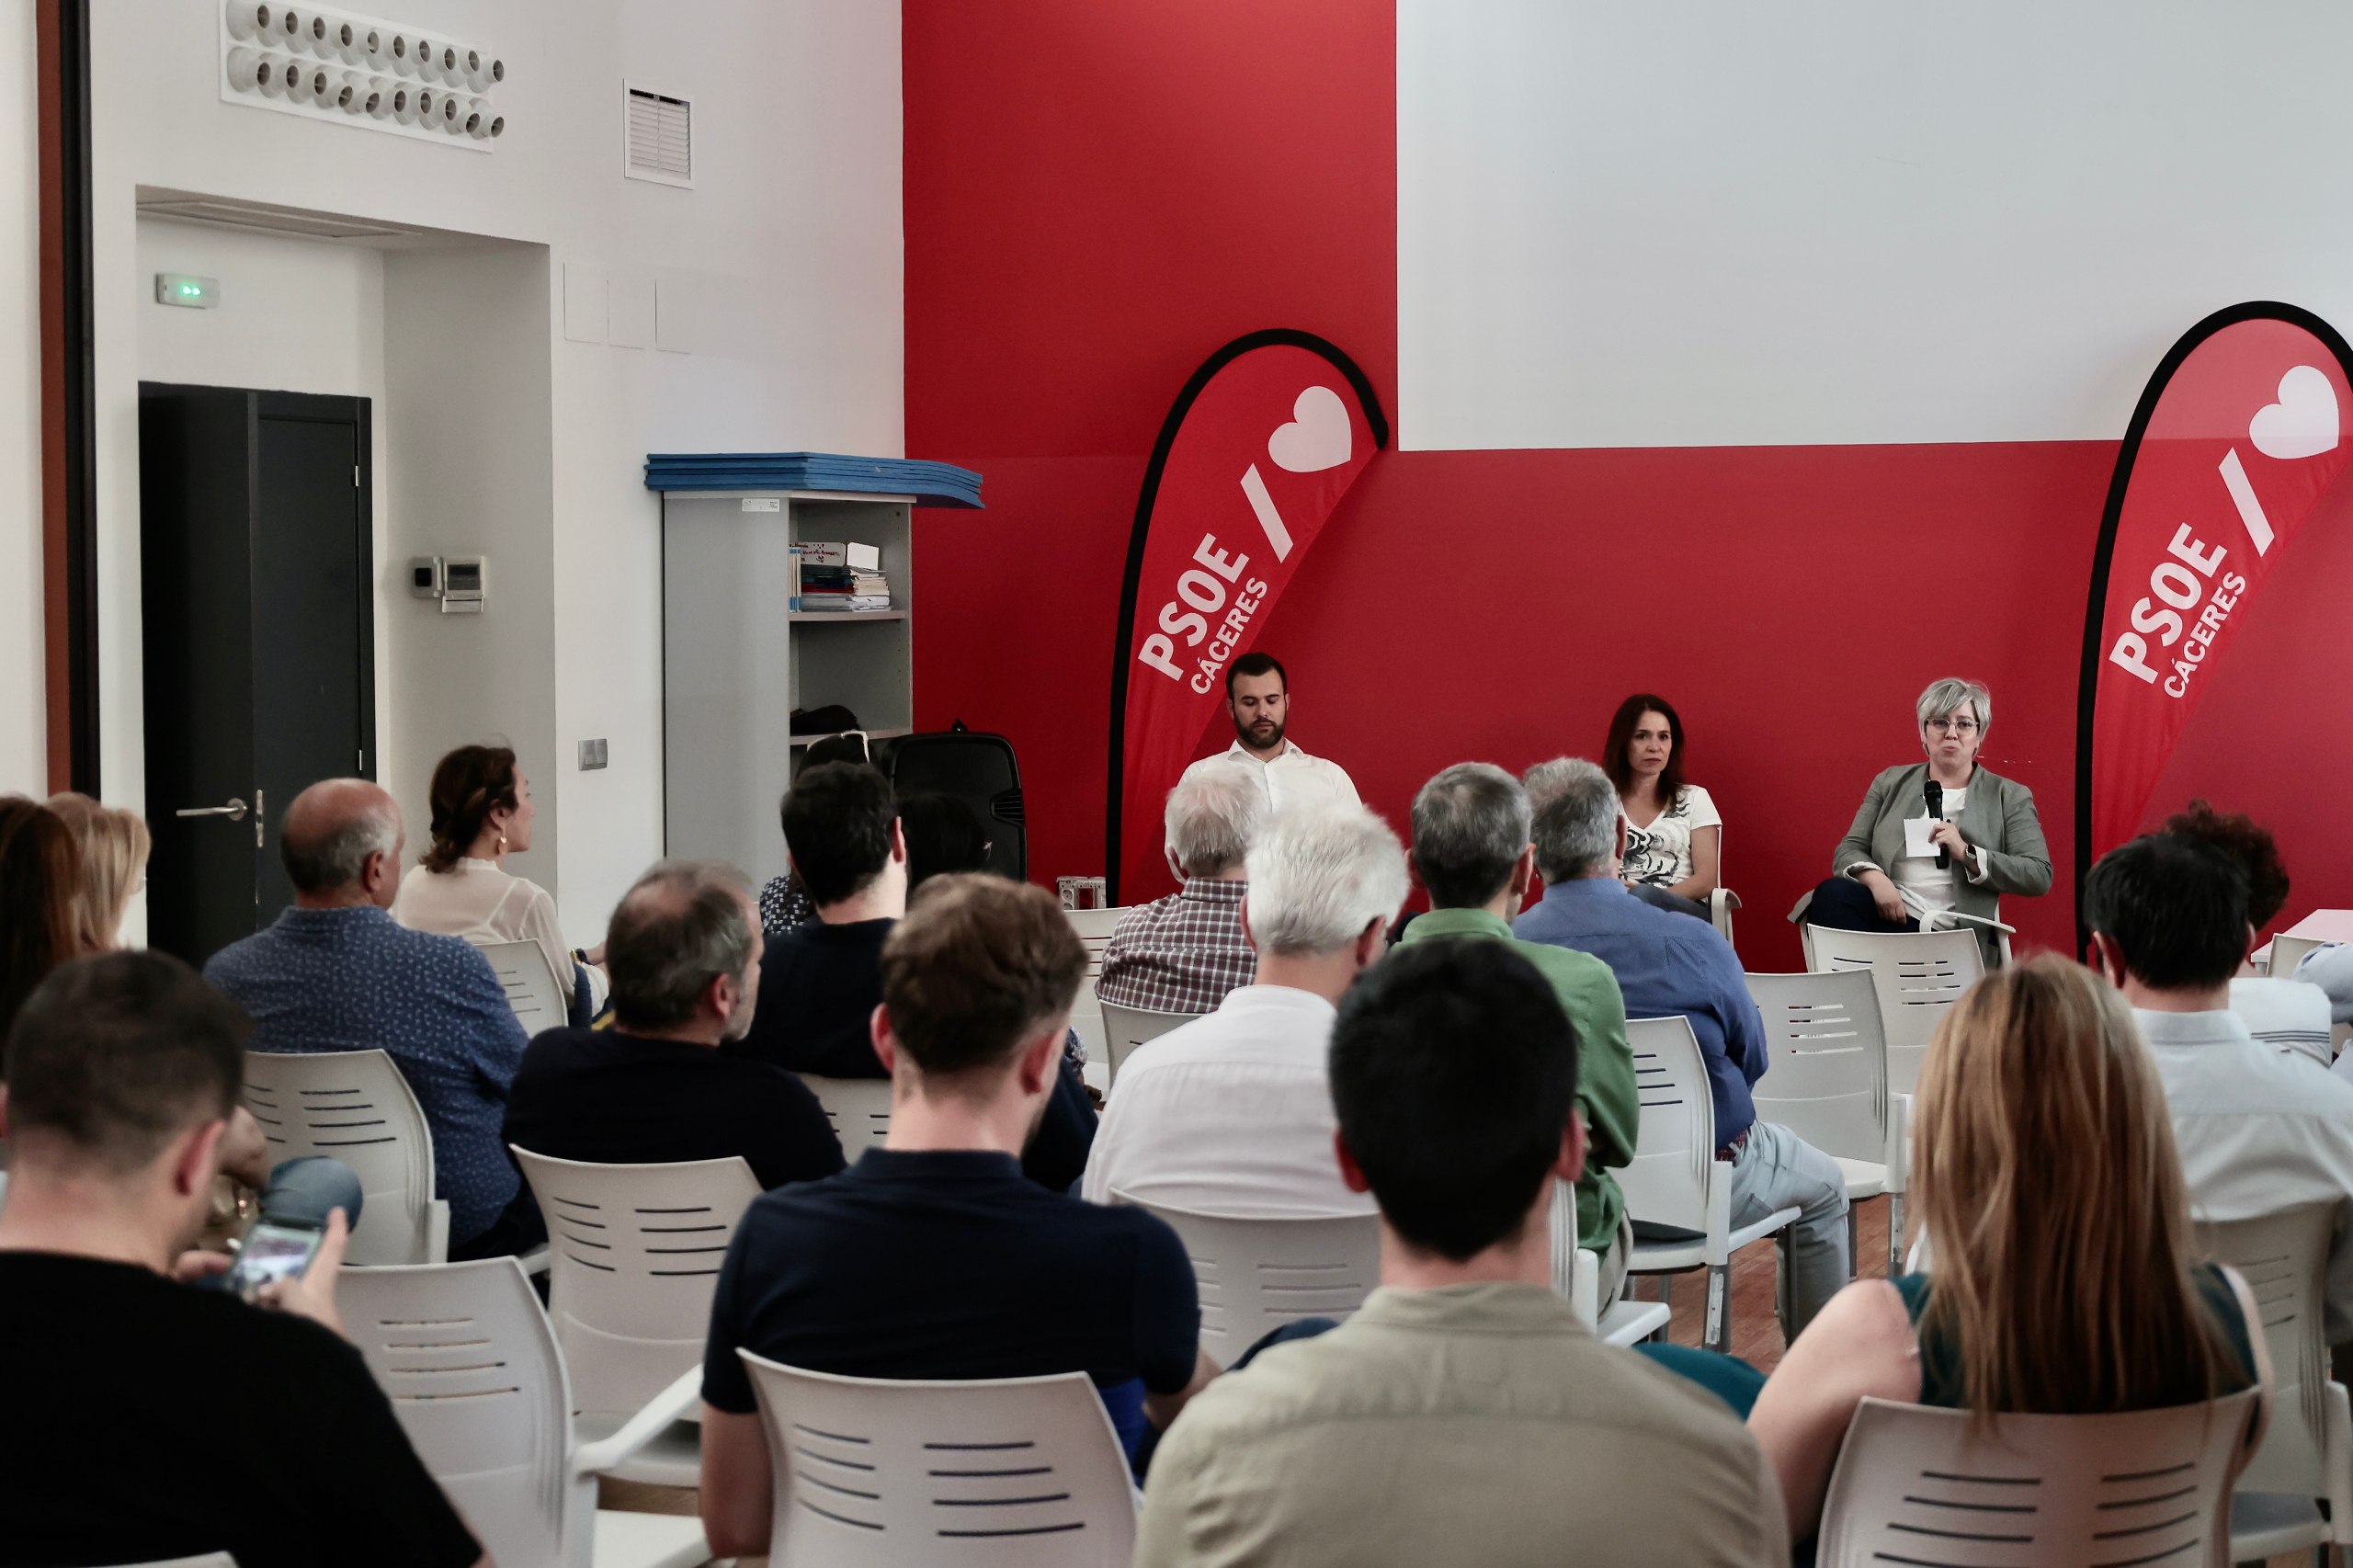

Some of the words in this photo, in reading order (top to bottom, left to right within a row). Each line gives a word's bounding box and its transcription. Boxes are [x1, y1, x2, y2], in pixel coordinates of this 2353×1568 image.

[1138, 533, 1250, 682] PSOE
[1190, 577, 1267, 695] CÁCERES
[2109, 522, 2228, 685] PSOE
[2164, 571, 2246, 699] CÁCERES
